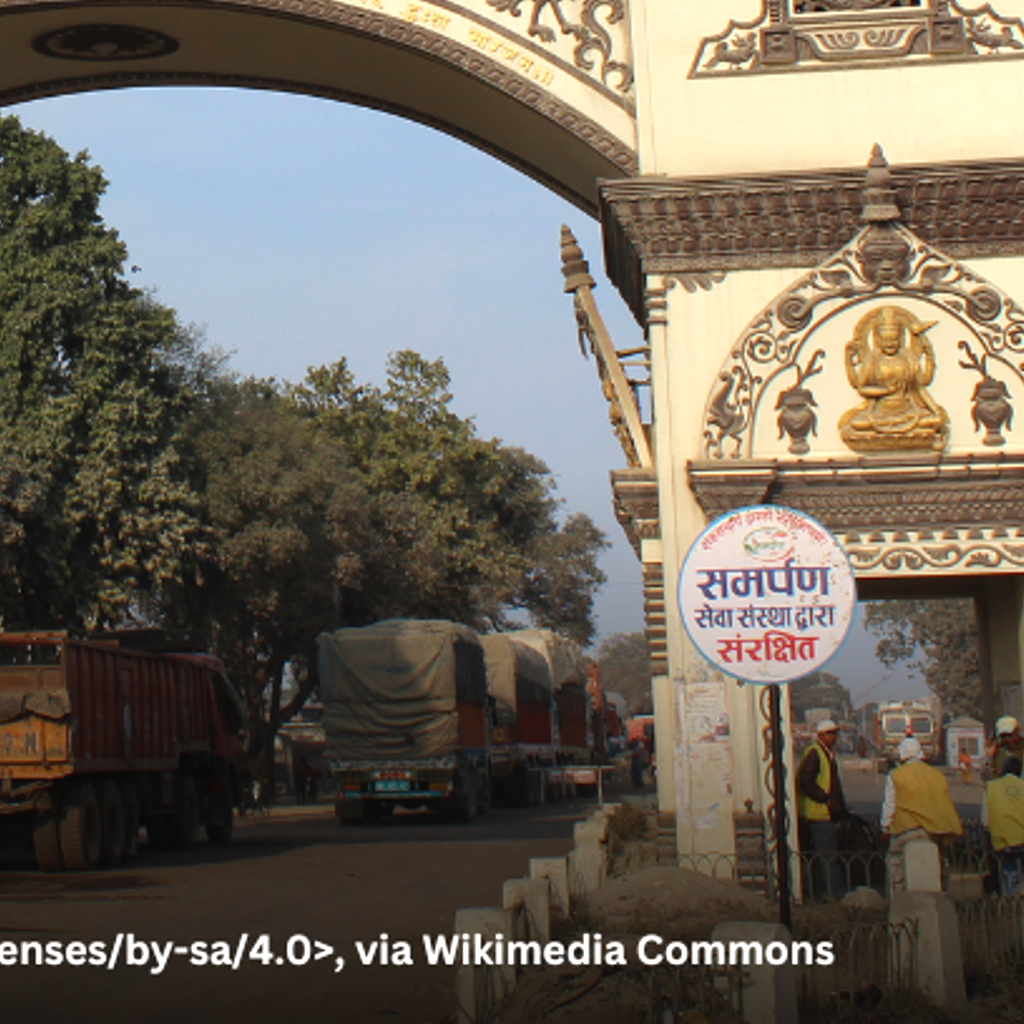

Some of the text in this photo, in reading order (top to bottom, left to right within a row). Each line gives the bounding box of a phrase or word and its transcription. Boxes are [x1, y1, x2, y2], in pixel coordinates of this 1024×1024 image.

[696, 557, 831, 601] समर्पण
[694, 602, 836, 631] सेवा संस्था द्वारा
[717, 630, 820, 664] संरक्षित
